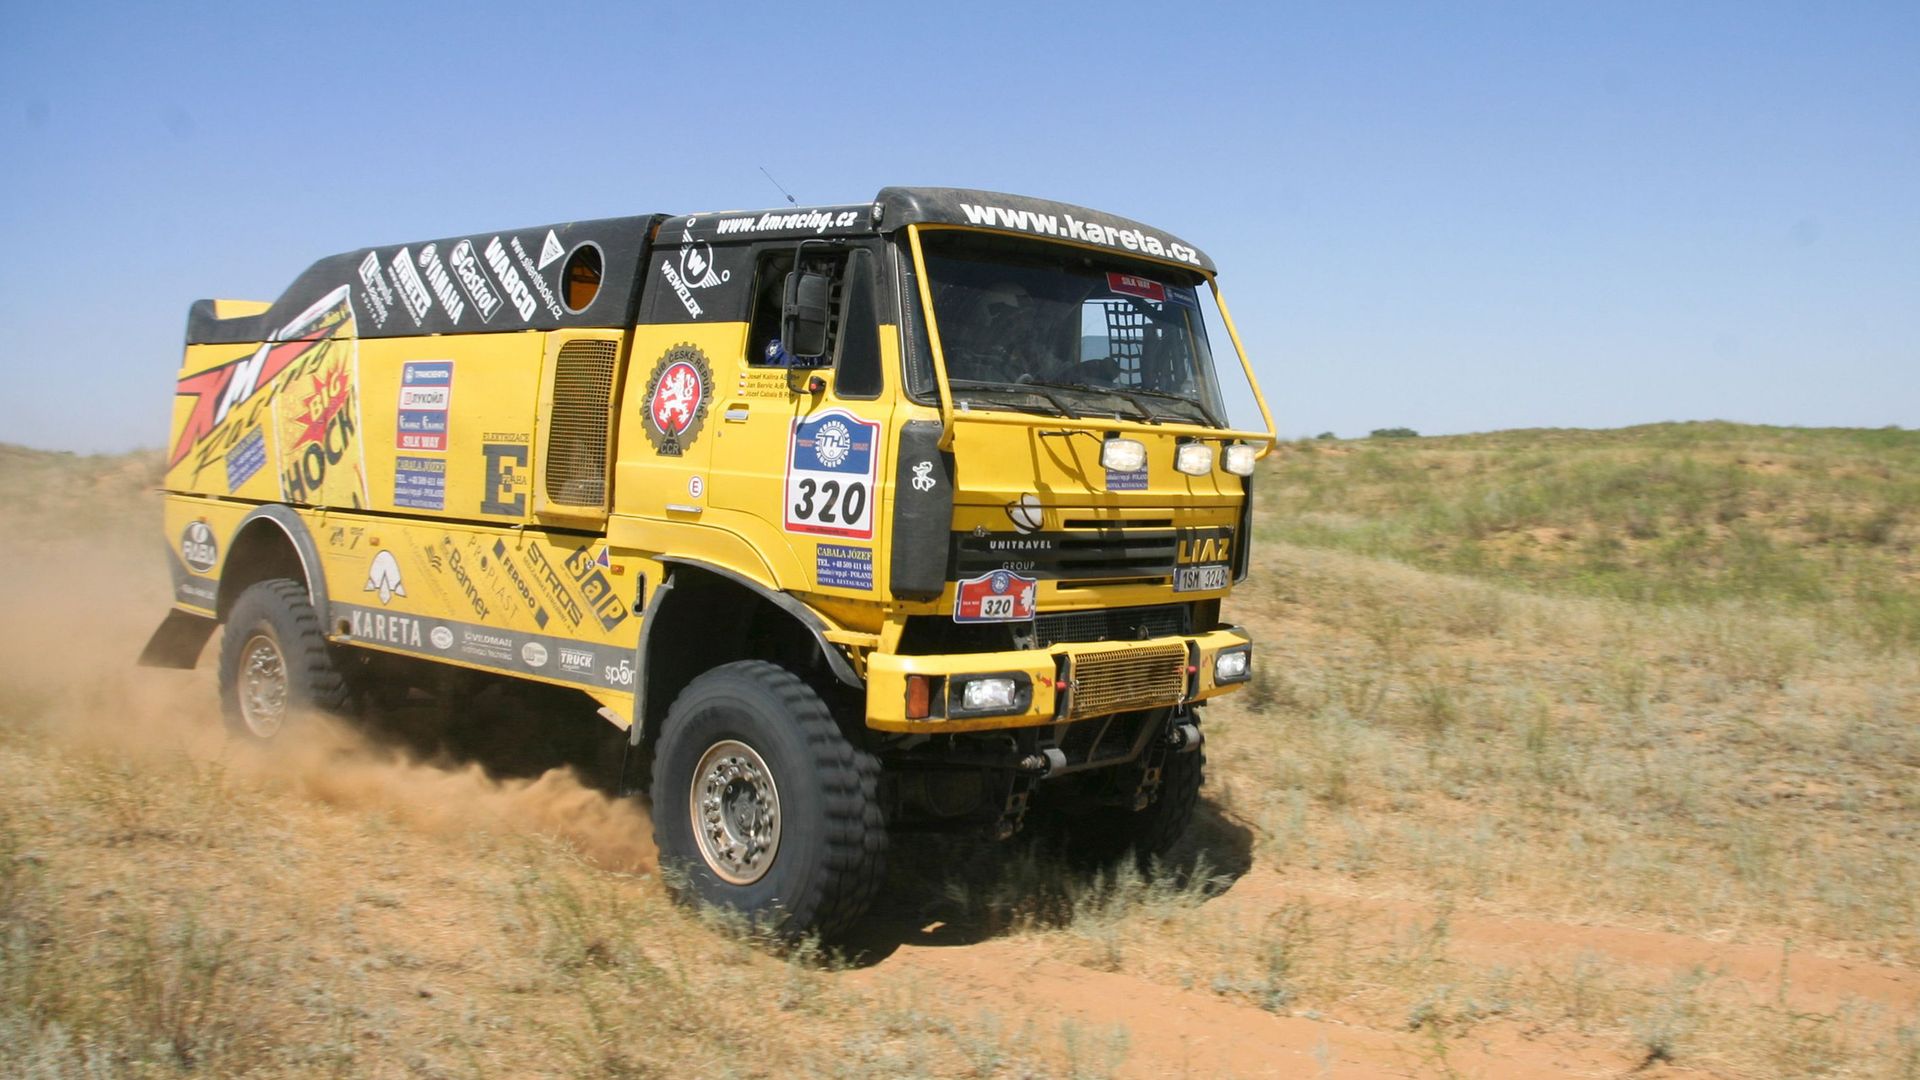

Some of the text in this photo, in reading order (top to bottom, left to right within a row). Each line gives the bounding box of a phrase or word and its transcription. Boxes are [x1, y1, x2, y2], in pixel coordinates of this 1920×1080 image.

[716, 209, 858, 235] www.kmracing.cz
[960, 203, 1201, 266] www.kareta.cz
[425, 254, 464, 325] YAMAHA
[458, 256, 498, 317] Castrol
[484, 236, 537, 322] WABCO
[510, 236, 563, 321] www.silentbloky.cz
[661, 260, 703, 320] WEWELER
[308, 370, 342, 423] BIG
[403, 435, 440, 448] SILK WAY
[794, 478, 866, 525] 320
[817, 547, 872, 561] CABALA JÓZEF
[990, 540, 1052, 550] UNITRAVEL
[1002, 561, 1035, 570] GROUP
[1177, 537, 1230, 565] LIAZ
[448, 547, 490, 620] Banner
[503, 556, 536, 609] FERODO
[527, 540, 584, 628] STRUS
[1183, 570, 1200, 589] 1SM
[352, 610, 422, 648] KARETA
[984, 599, 1011, 616] 320
[560, 652, 593, 668] TRUCK
